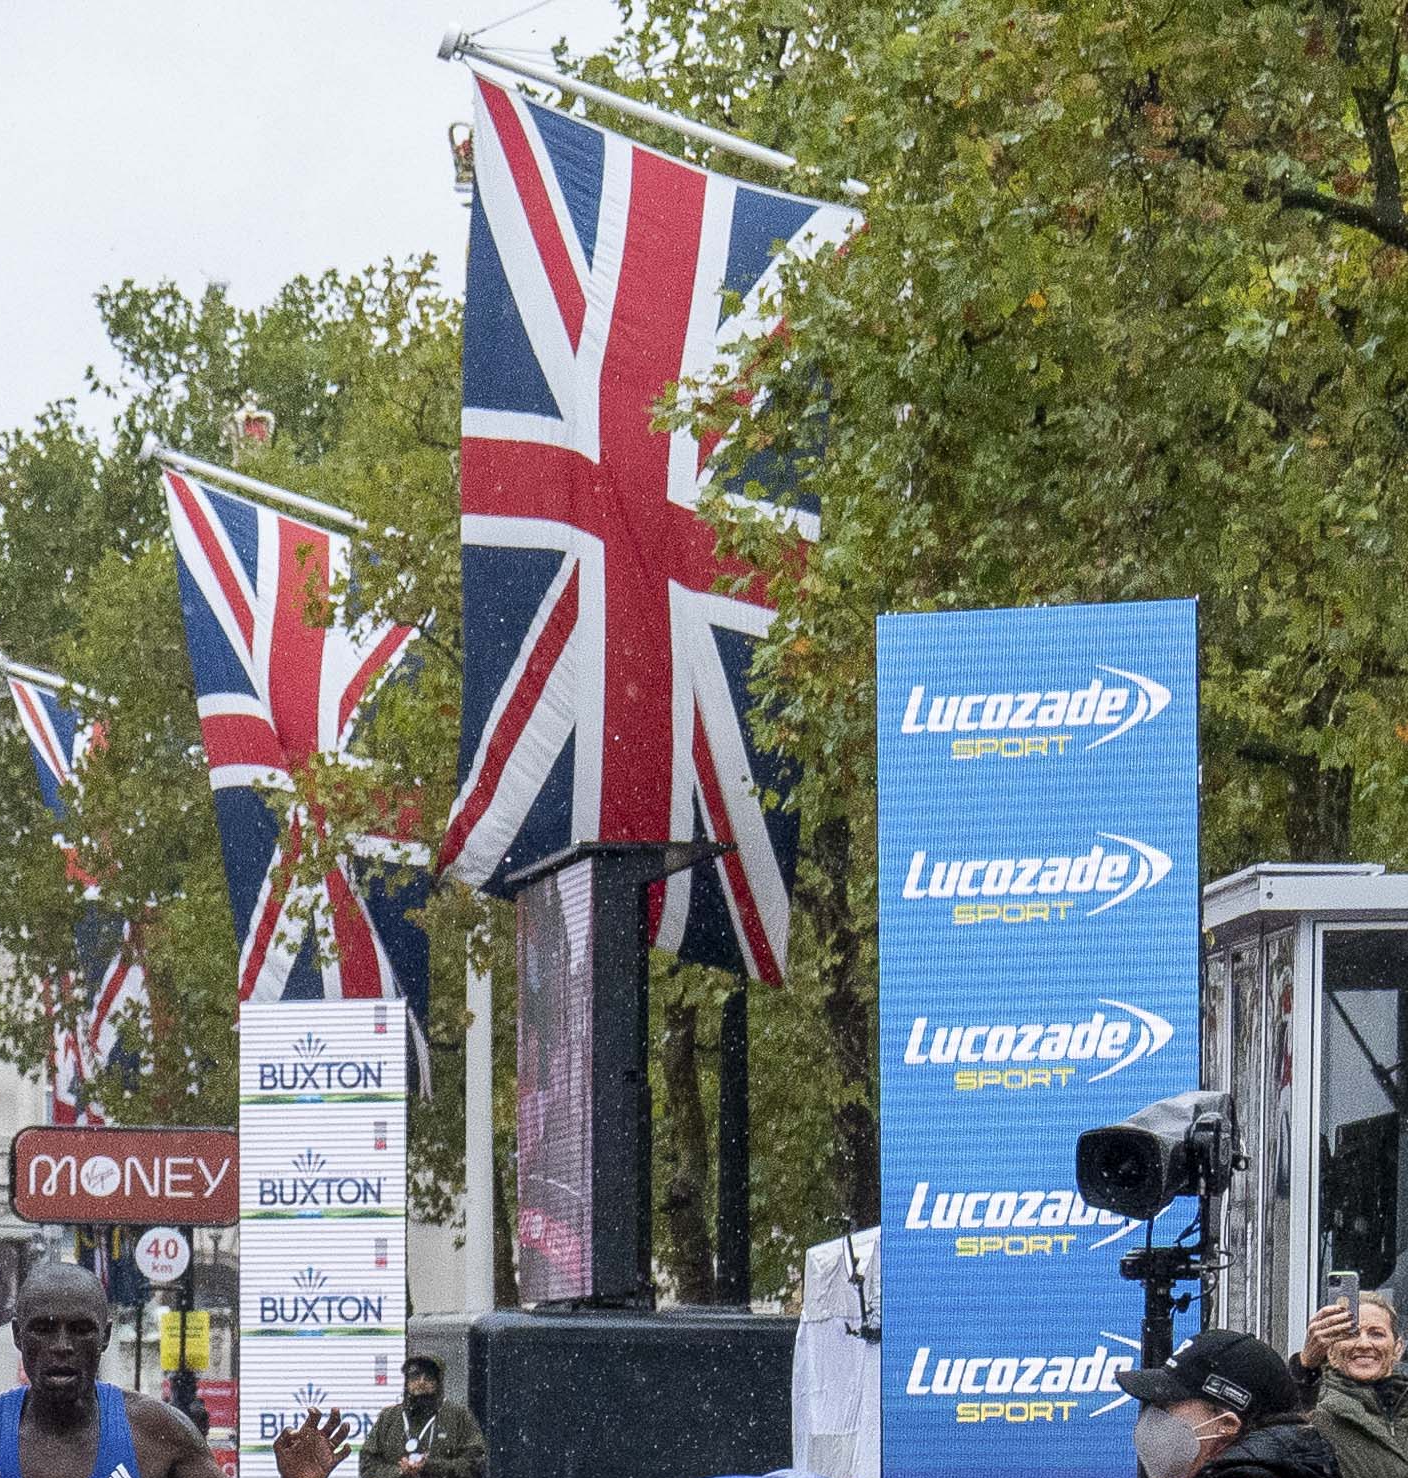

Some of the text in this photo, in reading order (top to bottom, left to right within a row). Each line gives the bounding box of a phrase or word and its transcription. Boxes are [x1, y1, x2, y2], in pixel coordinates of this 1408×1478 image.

[901, 678, 1129, 734] Lucozade
[951, 735, 1072, 760] SPORT
[902, 845, 1130, 899] Lucozade
[953, 901, 1073, 925] SPORT
[904, 1012, 1131, 1065] Lucozade
[259, 1062, 382, 1089] BUXTON
[954, 1067, 1076, 1091] SPORT
[29, 1155, 230, 1198] MONEY
[259, 1178, 381, 1205] BUXTON
[146, 1239, 178, 1259] 40
[955, 1235, 1077, 1257] SPORT
[151, 1262, 173, 1272] km
[260, 1296, 382, 1323] BUXTON
[956, 1402, 1078, 1423] SPORT
